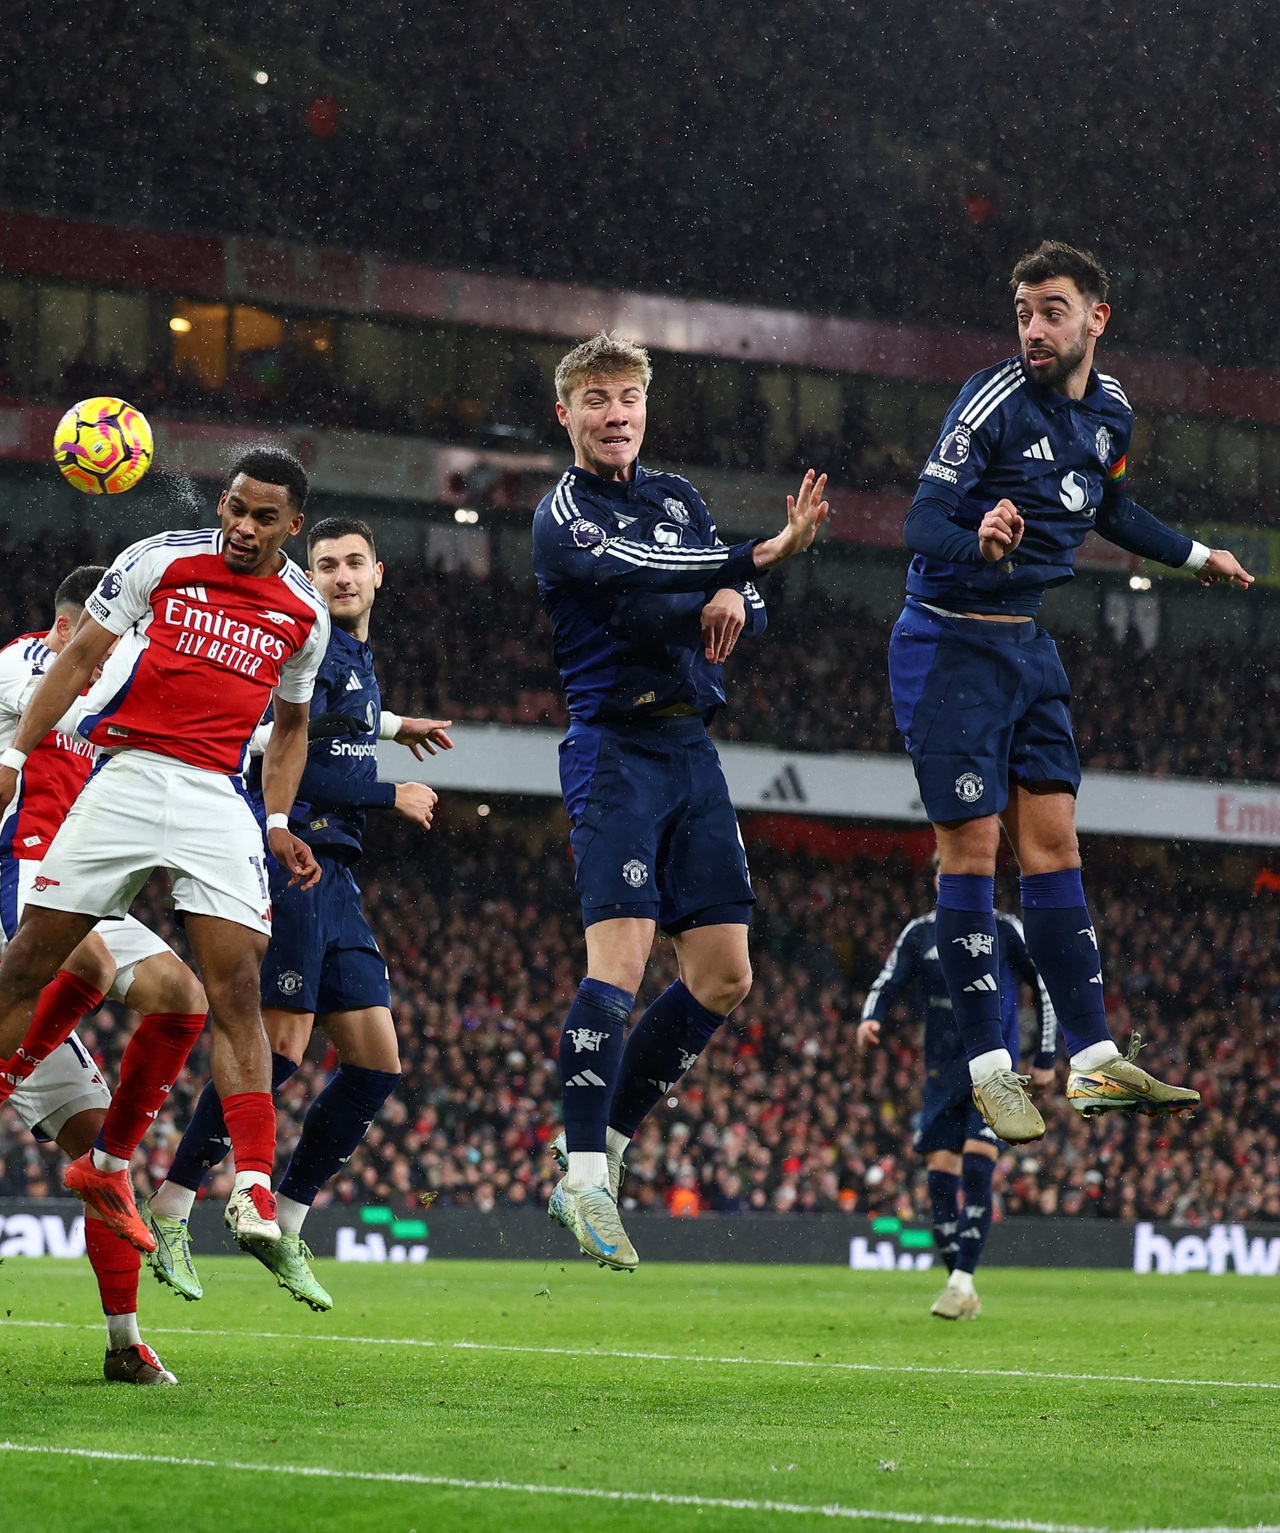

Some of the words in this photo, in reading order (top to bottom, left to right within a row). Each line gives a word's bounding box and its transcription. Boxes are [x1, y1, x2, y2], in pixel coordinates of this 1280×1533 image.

[165, 598, 286, 661] Emirates
[176, 631, 207, 656] FLY
[207, 640, 263, 678] BETTER
